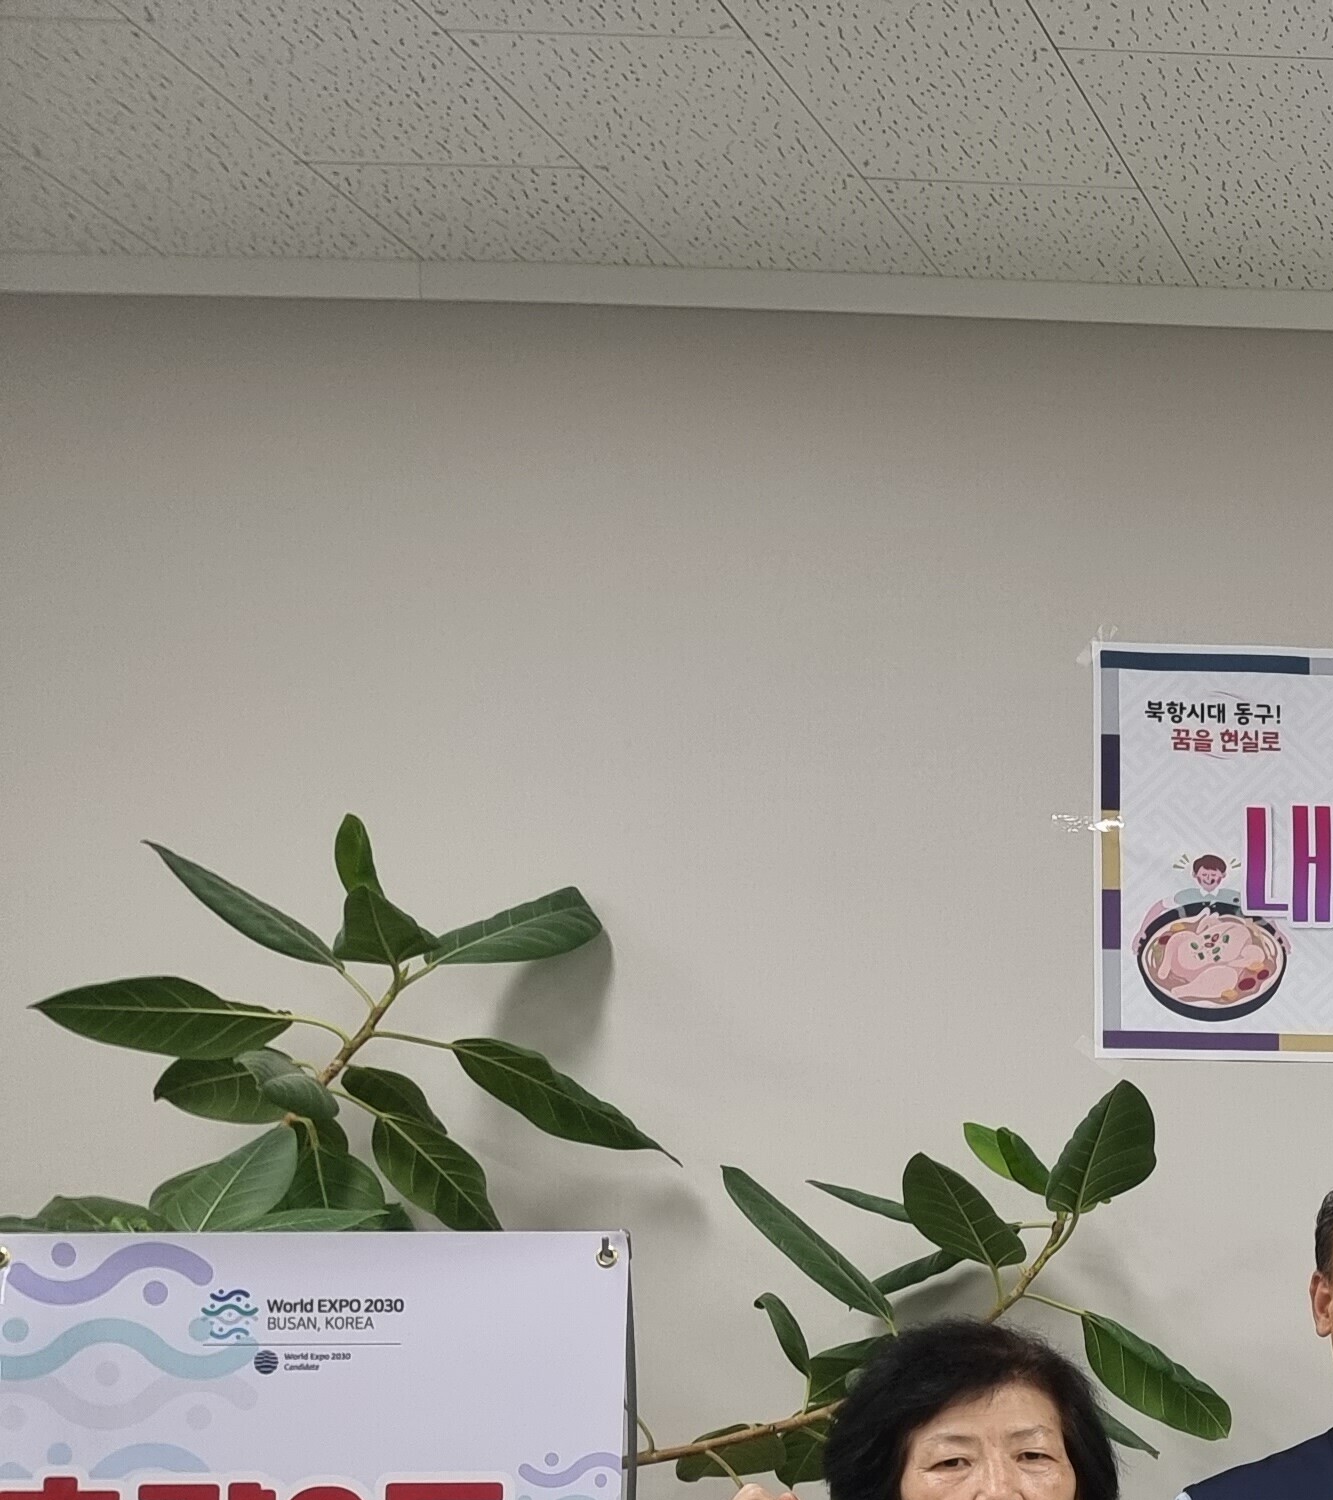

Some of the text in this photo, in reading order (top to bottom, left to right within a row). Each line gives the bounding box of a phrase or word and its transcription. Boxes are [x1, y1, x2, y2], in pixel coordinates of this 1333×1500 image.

[1145, 701, 1281, 725] 북항시대 동구!
[1171, 728, 1281, 753] 꿈을 현실로
[1243, 806, 1332, 924] 내
[267, 1298, 405, 1313] World EXPO 2030
[267, 1316, 375, 1332] BUSAN, KOREA
[284, 1352, 352, 1362] World Expo 2030
[284, 1363, 320, 1371] Candidate
